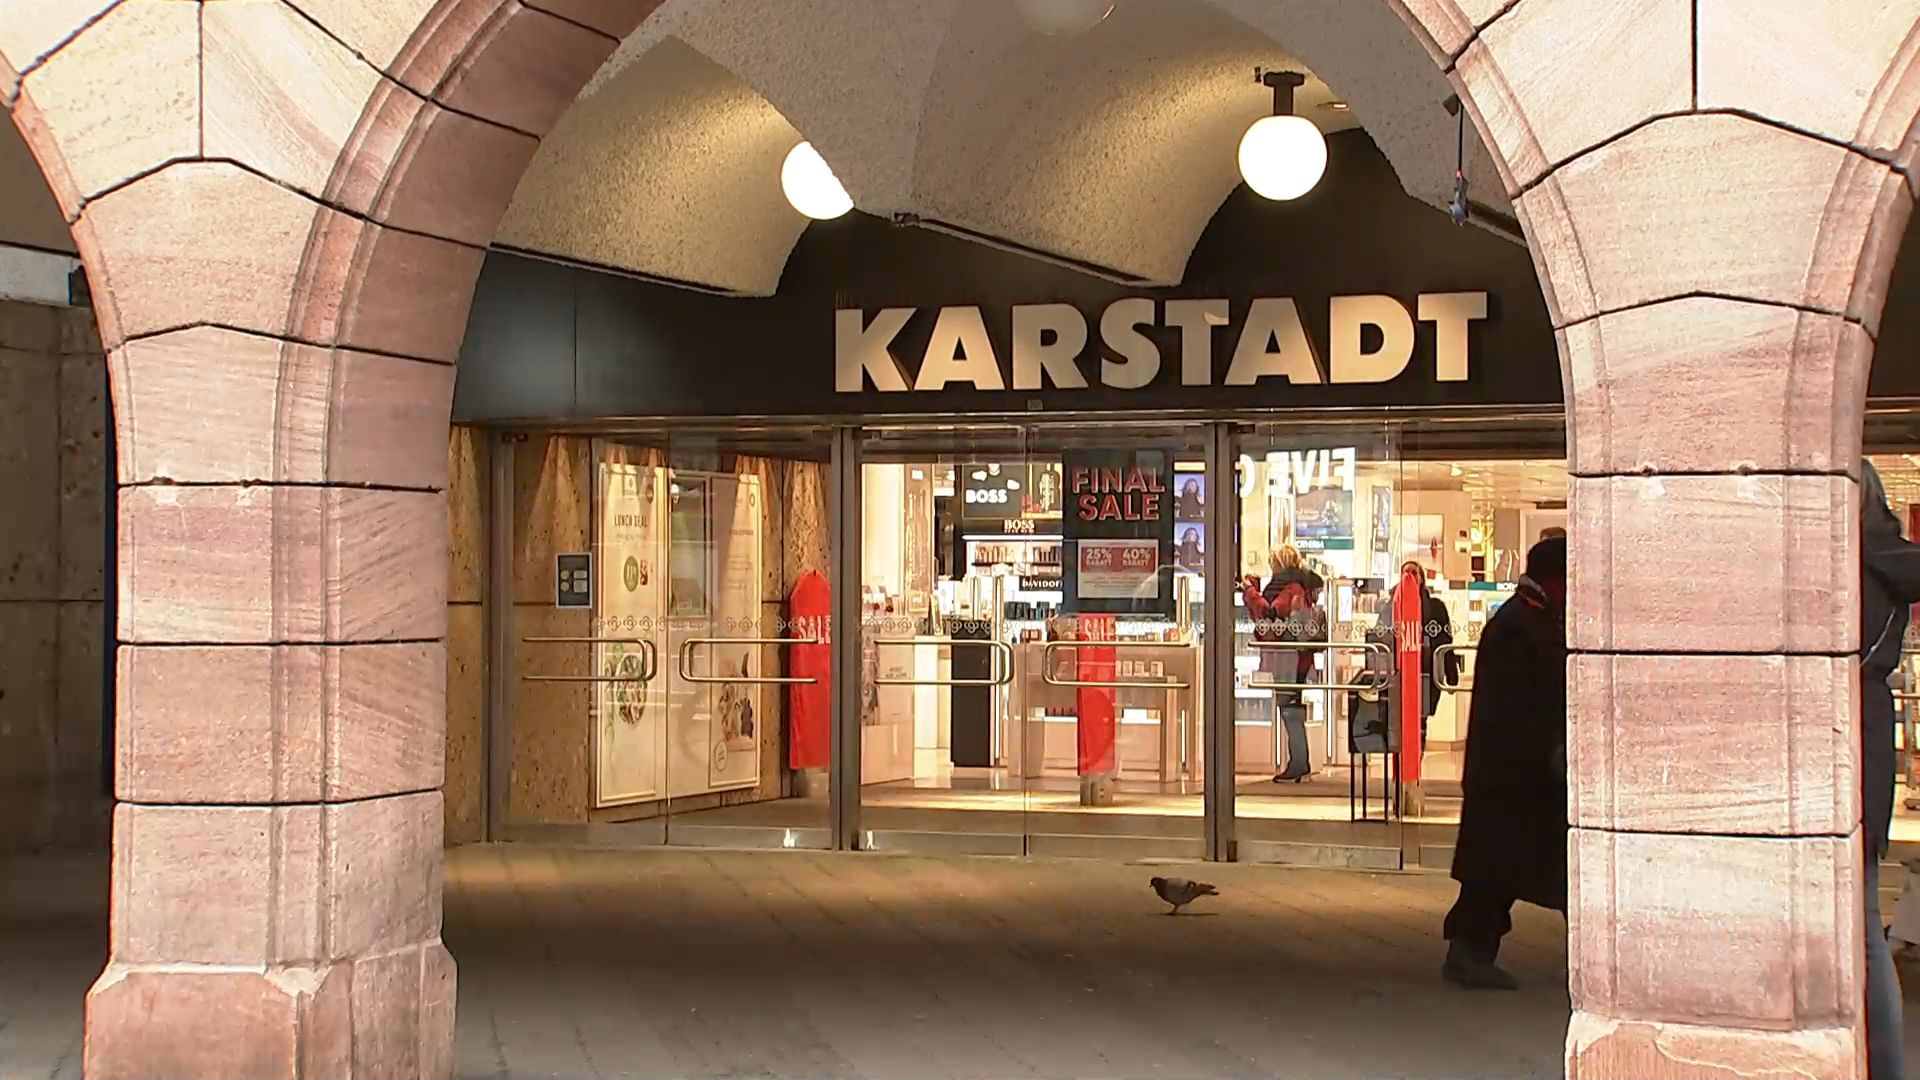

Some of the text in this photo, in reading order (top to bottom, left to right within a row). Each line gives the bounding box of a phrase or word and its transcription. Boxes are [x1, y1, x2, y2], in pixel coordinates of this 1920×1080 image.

[834, 290, 1489, 394] KARSTADT
[1072, 467, 1165, 493] FINAL
[965, 488, 1008, 504] BOSS
[1078, 494, 1160, 521] SALE
[1004, 519, 1035, 530] BOSS
[1086, 548, 1151, 560] 25% 40%
[1022, 579, 1062, 588] DAVIDOF
[798, 615, 832, 645] SALE
[1401, 620, 1422, 652] SALE
